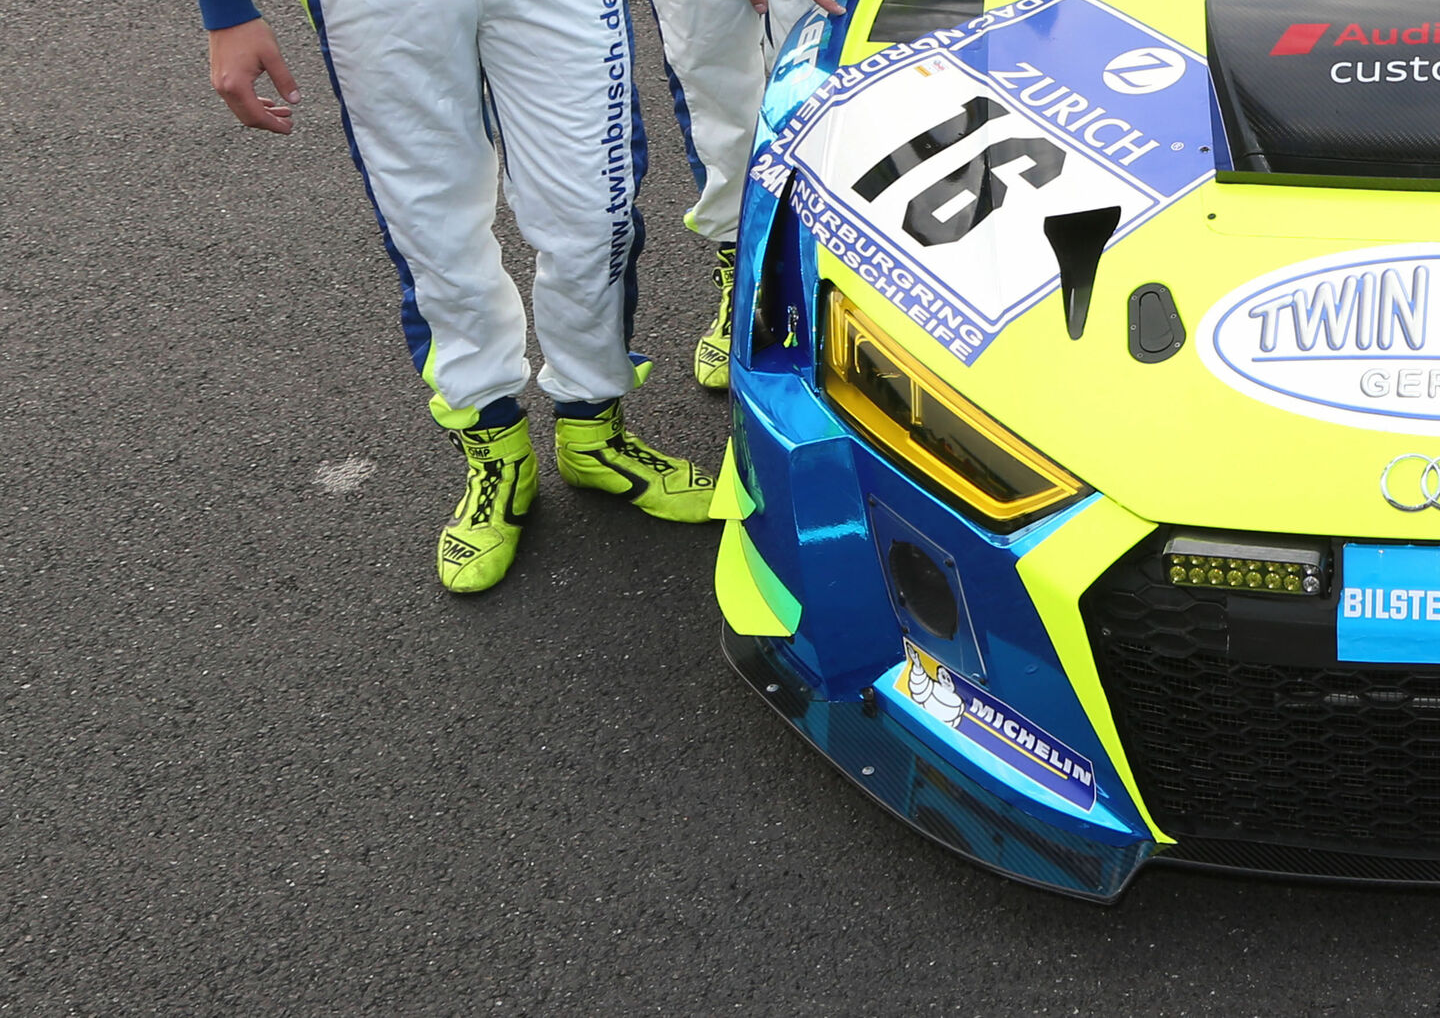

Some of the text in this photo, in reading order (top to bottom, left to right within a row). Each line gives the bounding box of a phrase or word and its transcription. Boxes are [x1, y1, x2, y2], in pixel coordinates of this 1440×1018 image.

[987, 61, 1161, 168] ZURICH
[851, 95, 1067, 247] 16
[791, 194, 973, 362] NORDSCHLEIFE
[797, 179, 986, 349] NÜRBURGRING
[1249, 264, 1430, 352] TWIN
[468, 447, 491, 459] OMP
[968, 696, 1093, 788] MICHELIN
